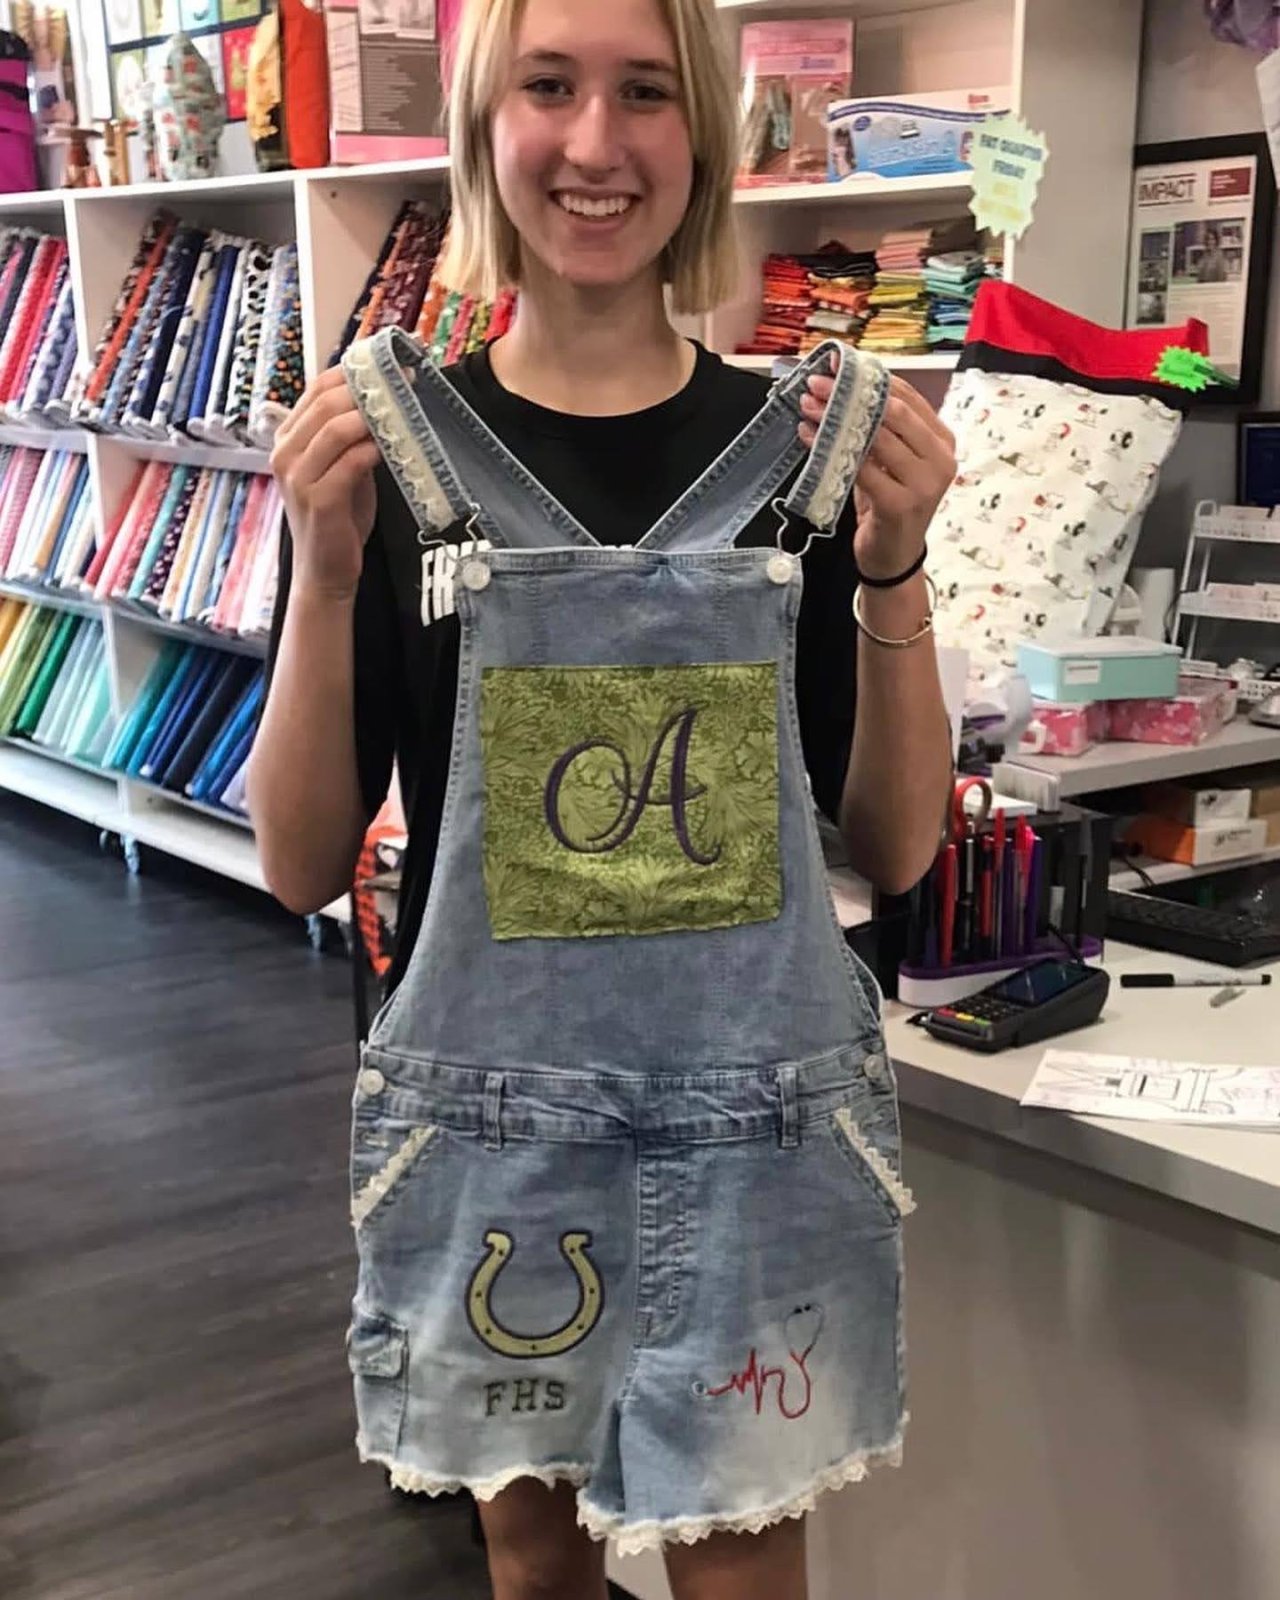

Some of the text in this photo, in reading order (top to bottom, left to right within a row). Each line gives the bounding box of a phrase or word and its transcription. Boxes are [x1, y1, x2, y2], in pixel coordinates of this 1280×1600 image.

[1139, 179, 1196, 201] IMPACT
[543, 702, 722, 866] A
[483, 1379, 567, 1416] FHS
